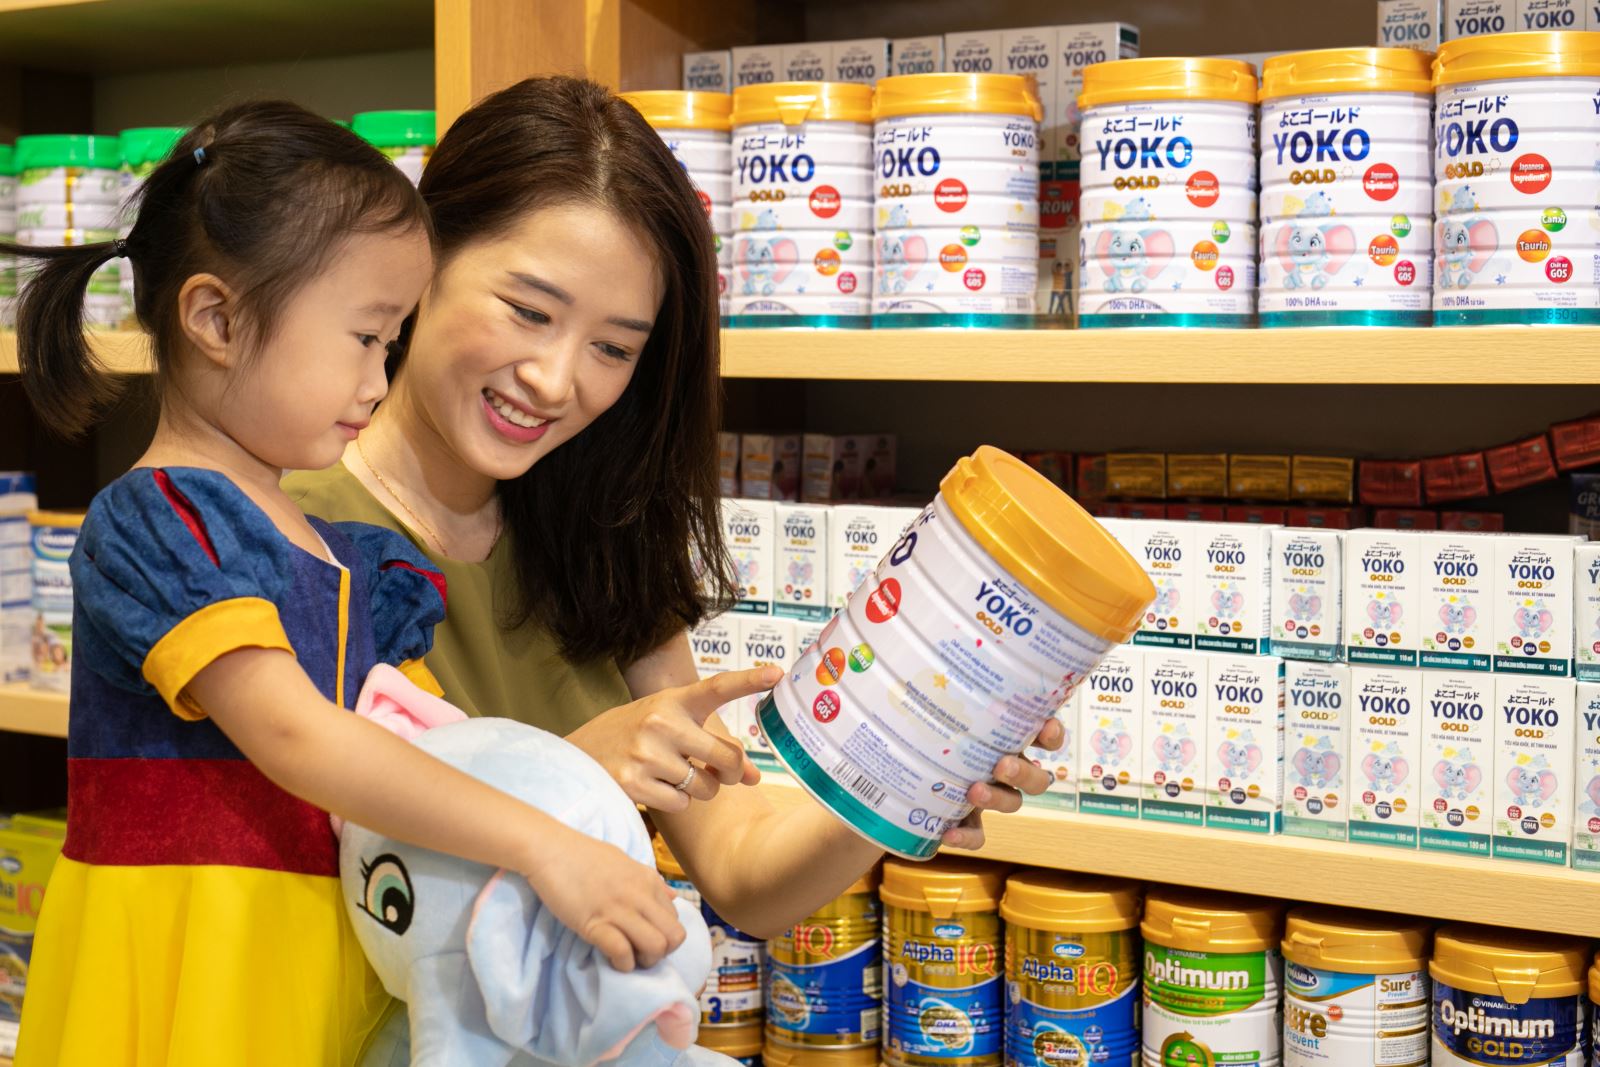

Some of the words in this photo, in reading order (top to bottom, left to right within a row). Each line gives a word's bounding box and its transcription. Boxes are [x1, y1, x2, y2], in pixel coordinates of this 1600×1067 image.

[1455, 16, 1505, 35] YOKO
[1524, 10, 1575, 29] YOKO
[1382, 22, 1431, 42] YOKO
[953, 58, 993, 73] YOKO
[1007, 54, 1049, 71] YOKO
[1064, 51, 1106, 67] YOKO
[738, 70, 774, 86] YOKO
[787, 68, 824, 81] YOKO
[836, 64, 876, 80] YOKO
[687, 74, 723, 88] YOKO
[1102, 116, 1183, 134] よこゴールド
[1279, 107, 1361, 128] よこゴールド
[1003, 132, 1034, 148] YOKO
[1437, 117, 1519, 159] YOKO
[1096, 136, 1193, 171] YOKO
[1273, 128, 1370, 165] YOKO
[737, 154, 815, 185] YOKO
[1289, 169, 1336, 185] GOLD
[1445, 161, 1483, 179] GOLD
[1113, 175, 1160, 190] GOLD
[749, 189, 785, 202] GOLD
[881, 184, 912, 198] GOLD
[1541, 215, 1566, 225] Canxi
[1371, 245, 1397, 256] Taurin
[1519, 241, 1548, 251] Taurin
[941, 253, 966, 262] Taurin
[1194, 251, 1217, 261] Taurin
[1397, 272, 1412, 281] GOS
[1551, 269, 1567, 278] GOS
[1218, 277, 1231, 286] GOS
[1109, 300, 1128, 310] 100%
[1129, 300, 1145, 310] DHA
[1285, 298, 1303, 307] 100%
[1305, 297, 1320, 306] DHA
[1456, 296, 1469, 306] DHA
[728, 524, 760, 536] YOKO
[784, 525, 815, 539] YOKO
[845, 531, 877, 545] YOKO
[1145, 547, 1182, 561] YOKO
[1207, 549, 1245, 565] YOKO
[1283, 552, 1324, 568] YOKO
[1437, 553, 1475, 561] よこゴールド
[1512, 556, 1551, 565] よこゴールド
[1292, 568, 1314, 576] GOLD
[1362, 558, 1404, 573] YOKO
[1434, 561, 1478, 577] YOKO
[1508, 564, 1555, 580] YOKO
[1370, 574, 1393, 582] GOLD
[1442, 577, 1467, 585] GOLD
[975, 581, 1033, 636] YOKO
[976, 611, 1003, 635] GOLD
[692, 639, 731, 654] YOKO
[746, 643, 785, 659] YOKO
[824, 654, 839, 681] Taurin
[1155, 669, 1195, 679] よこゴールド
[1090, 675, 1134, 693] YOKO
[1219, 674, 1260, 684] よこゴールド
[1295, 679, 1339, 688] よこゴールド
[1151, 680, 1197, 698] YOKO
[1215, 685, 1263, 703] YOKO
[1363, 684, 1407, 695] よこゴールド
[1434, 689, 1480, 700] よこゴールド
[1098, 695, 1121, 703] GOLD
[1161, 700, 1184, 709] GOLD
[1291, 690, 1341, 709] YOKO
[1359, 695, 1410, 715] YOKO
[1507, 694, 1555, 706] よこゴールド
[816, 701, 832, 719] GOS
[1225, 705, 1250, 714] GOLD
[1302, 711, 1328, 720] GOLD
[1430, 700, 1483, 721] YOKO
[1503, 706, 1559, 727] YOKO
[1369, 717, 1396, 726] GOLD
[1441, 722, 1469, 732] GOLD
[1515, 728, 1543, 738] GOLD
[785, 737, 811, 770] 850g
[1524, 822, 1537, 830] DHA
[795, 924, 836, 960] IQ
[1056, 945, 1083, 956] dielac
[1173, 950, 1207, 960] VINAMILK
[902, 940, 955, 964] Alpha
[957, 943, 997, 977] IQ
[1022, 958, 1074, 984] Alpha
[1077, 962, 1121, 998] IQ
[1145, 951, 1249, 990] Optimum
[1380, 979, 1411, 992] Sure
[1159, 990, 1226, 1008] COMFORT
[1481, 1001, 1517, 1010] VINAMILK
[707, 996, 722, 1023] 3
[1440, 999, 1555, 1038] Optimum
[1467, 1037, 1524, 1059] GOLD
